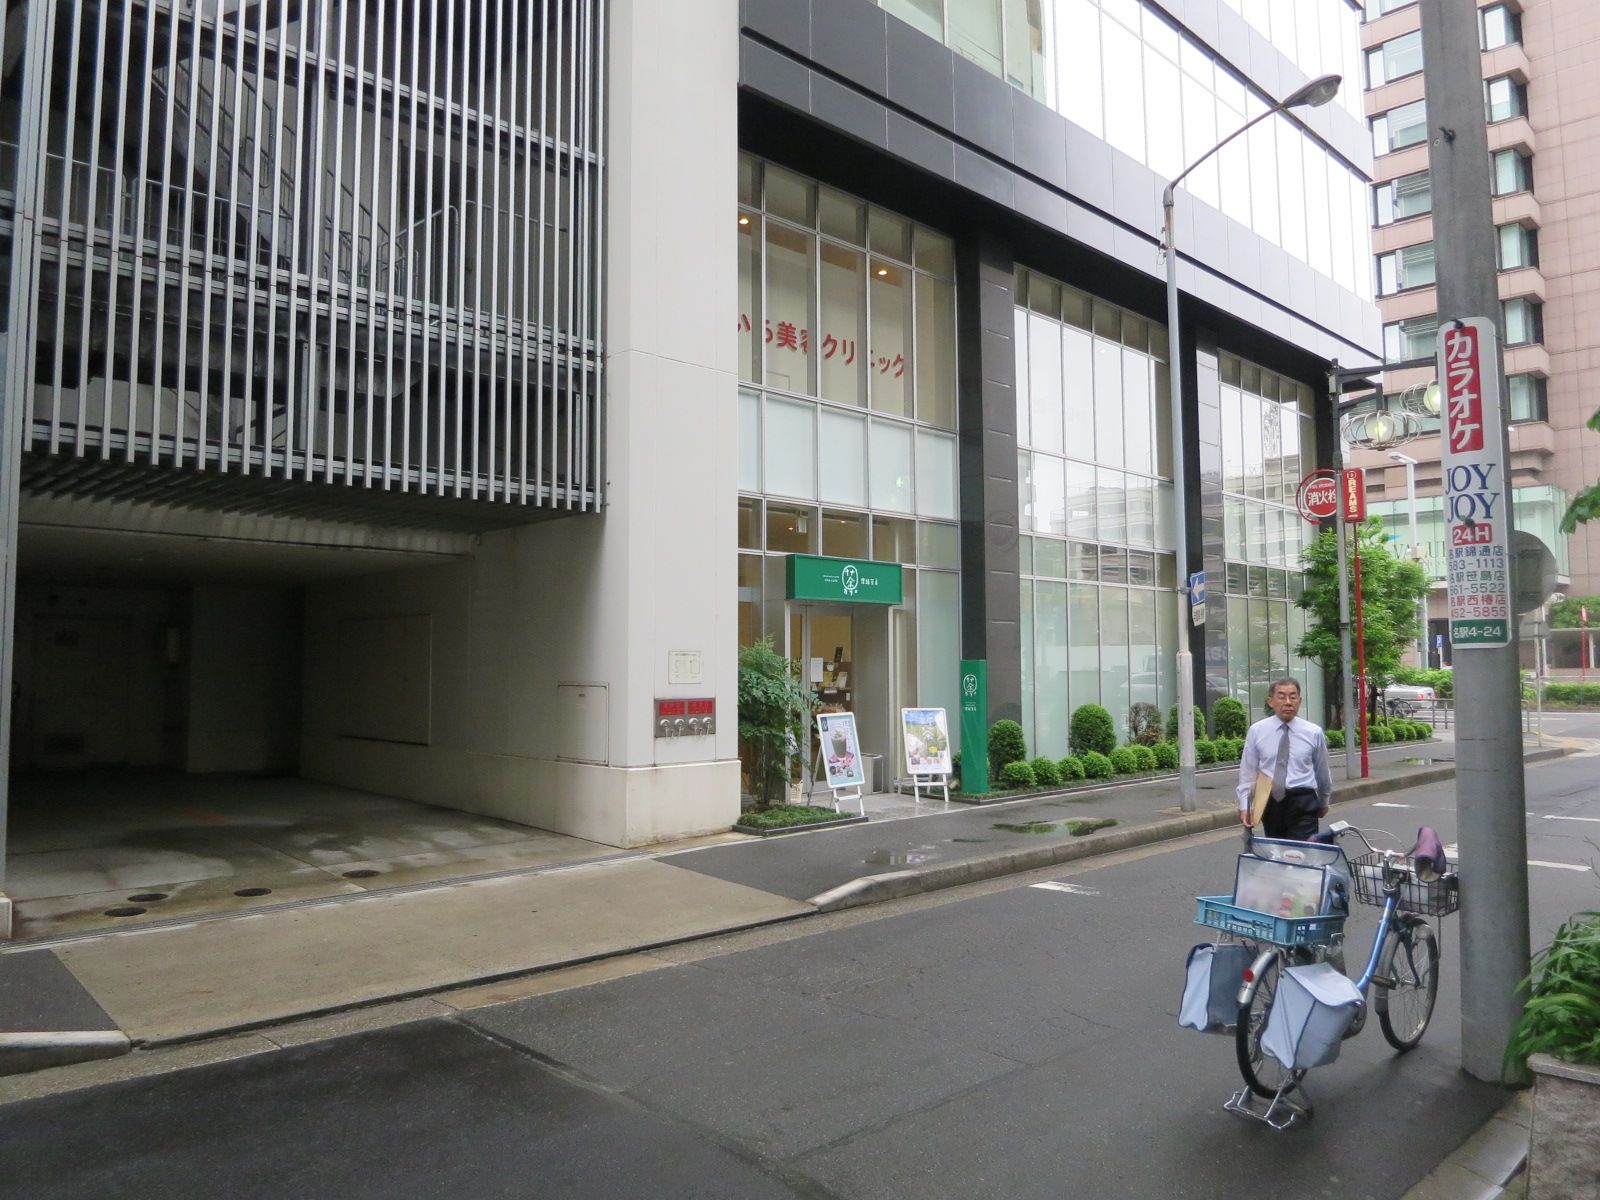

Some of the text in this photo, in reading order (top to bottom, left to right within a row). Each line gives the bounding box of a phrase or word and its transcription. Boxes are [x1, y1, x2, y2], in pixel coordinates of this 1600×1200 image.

[1447, 331, 1480, 450] カラオケ
[1347, 471, 1358, 513] DREAMS
[1445, 463, 1496, 495] JOY
[1447, 493, 1500, 523] JOY
[1453, 526, 1490, 544] 24H
[1449, 558, 1504, 572] 583-1113
